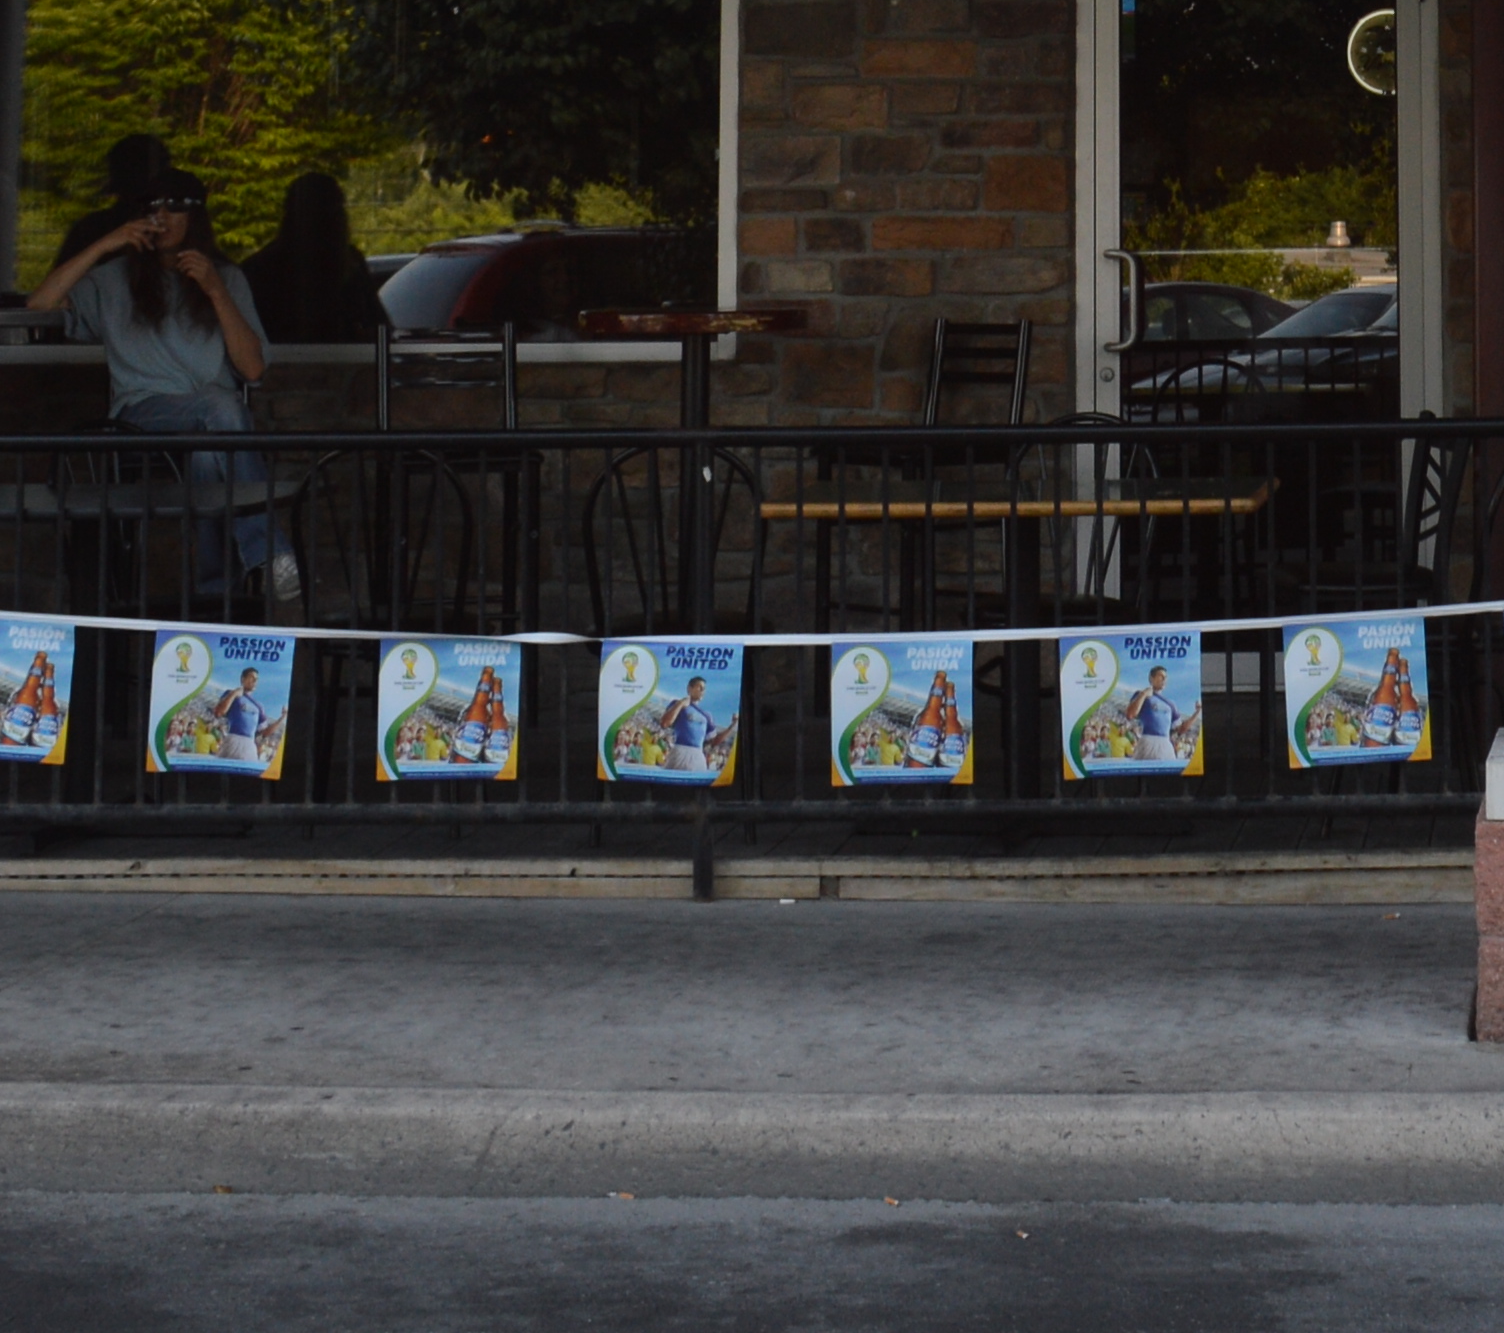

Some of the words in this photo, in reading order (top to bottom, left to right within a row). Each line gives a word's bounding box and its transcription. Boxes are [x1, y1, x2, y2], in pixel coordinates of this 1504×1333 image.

[1358, 620, 1415, 638] PASIÓN
[12, 638, 60, 651] UNIDA
[219, 636, 286, 653] PASSION
[1124, 635, 1191, 649] PASSION
[1363, 634, 1412, 649] UNIDA
[223, 647, 280, 663] UNITED
[458, 653, 506, 666] UNIDA
[666, 645, 734, 660] PASSION
[1129, 646, 1187, 660] UNITED
[670, 657, 728, 671] UNITED
[911, 658, 959, 670] UNIDA
